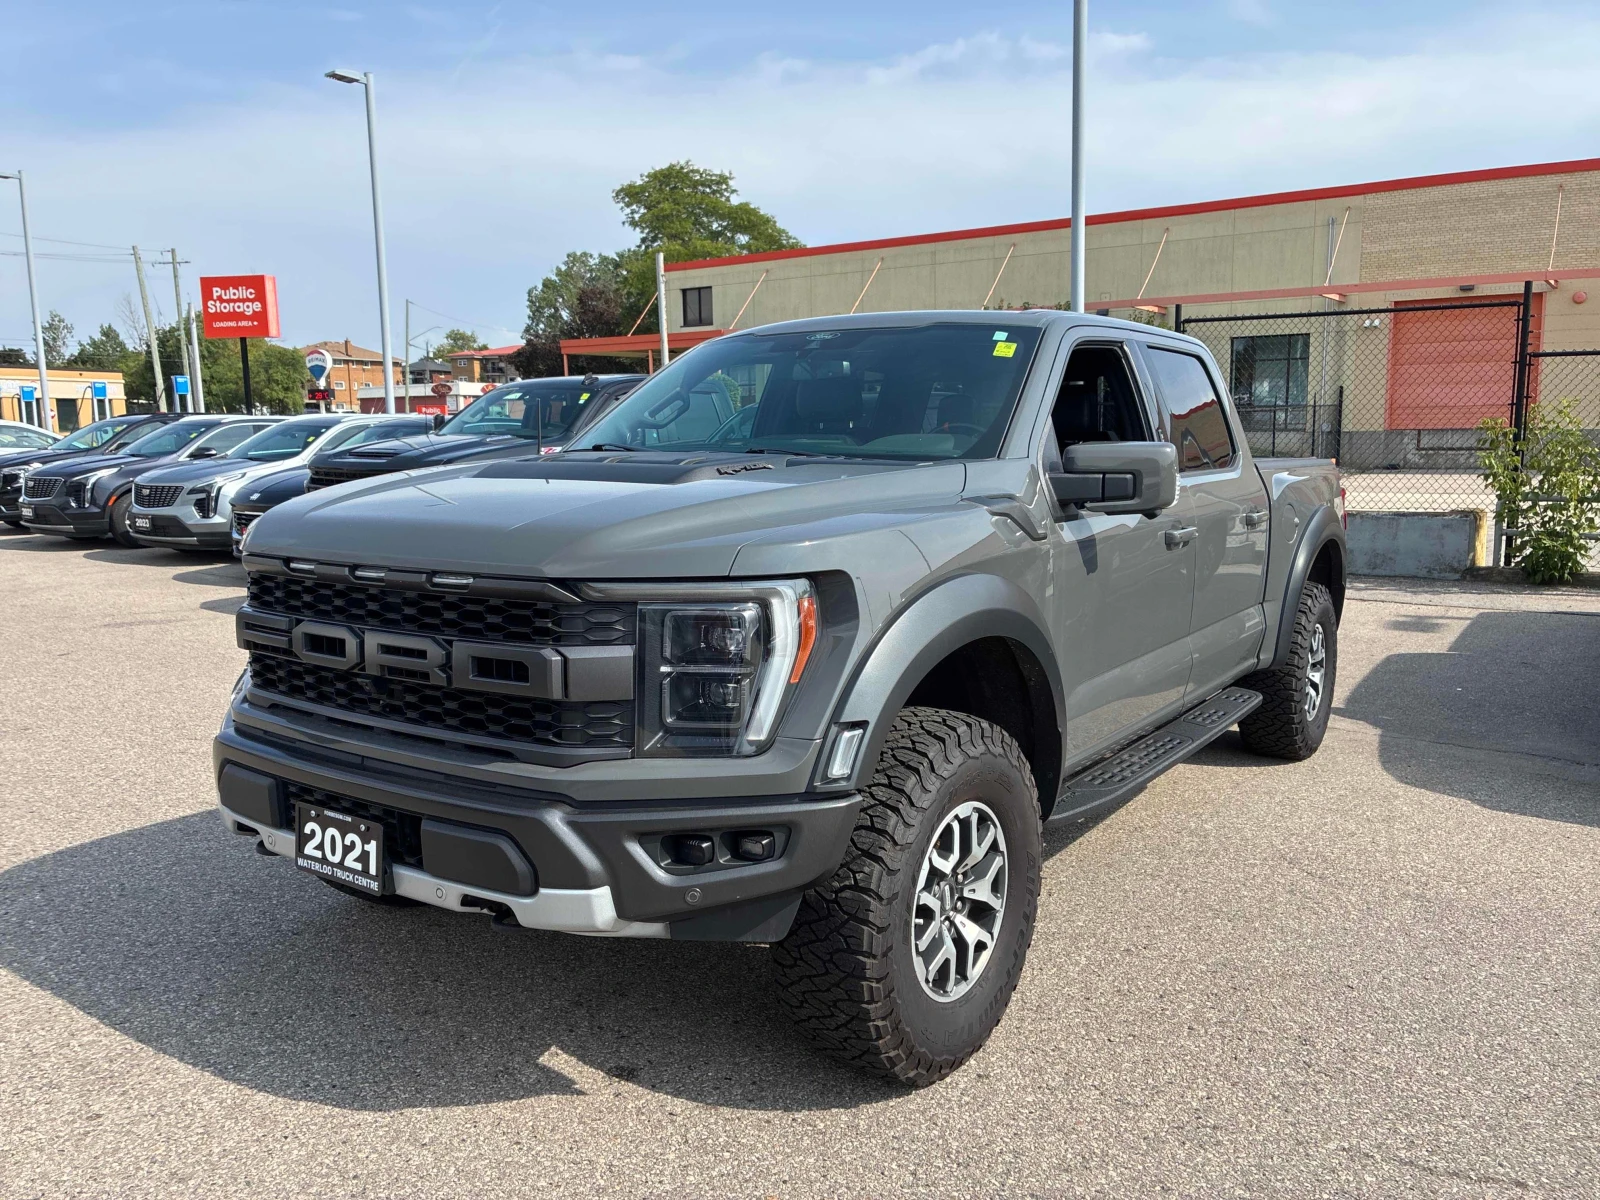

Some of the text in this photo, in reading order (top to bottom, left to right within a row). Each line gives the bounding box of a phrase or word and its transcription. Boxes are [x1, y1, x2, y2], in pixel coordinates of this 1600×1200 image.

[212, 287, 256, 300] Public
[207, 300, 262, 316] Storage
[135, 518, 150, 527] 2023
[236, 605, 565, 700] FORD
[304, 821, 377, 876] 2021
[297, 857, 379, 892] WATERLOO TRUCK CENTRE
